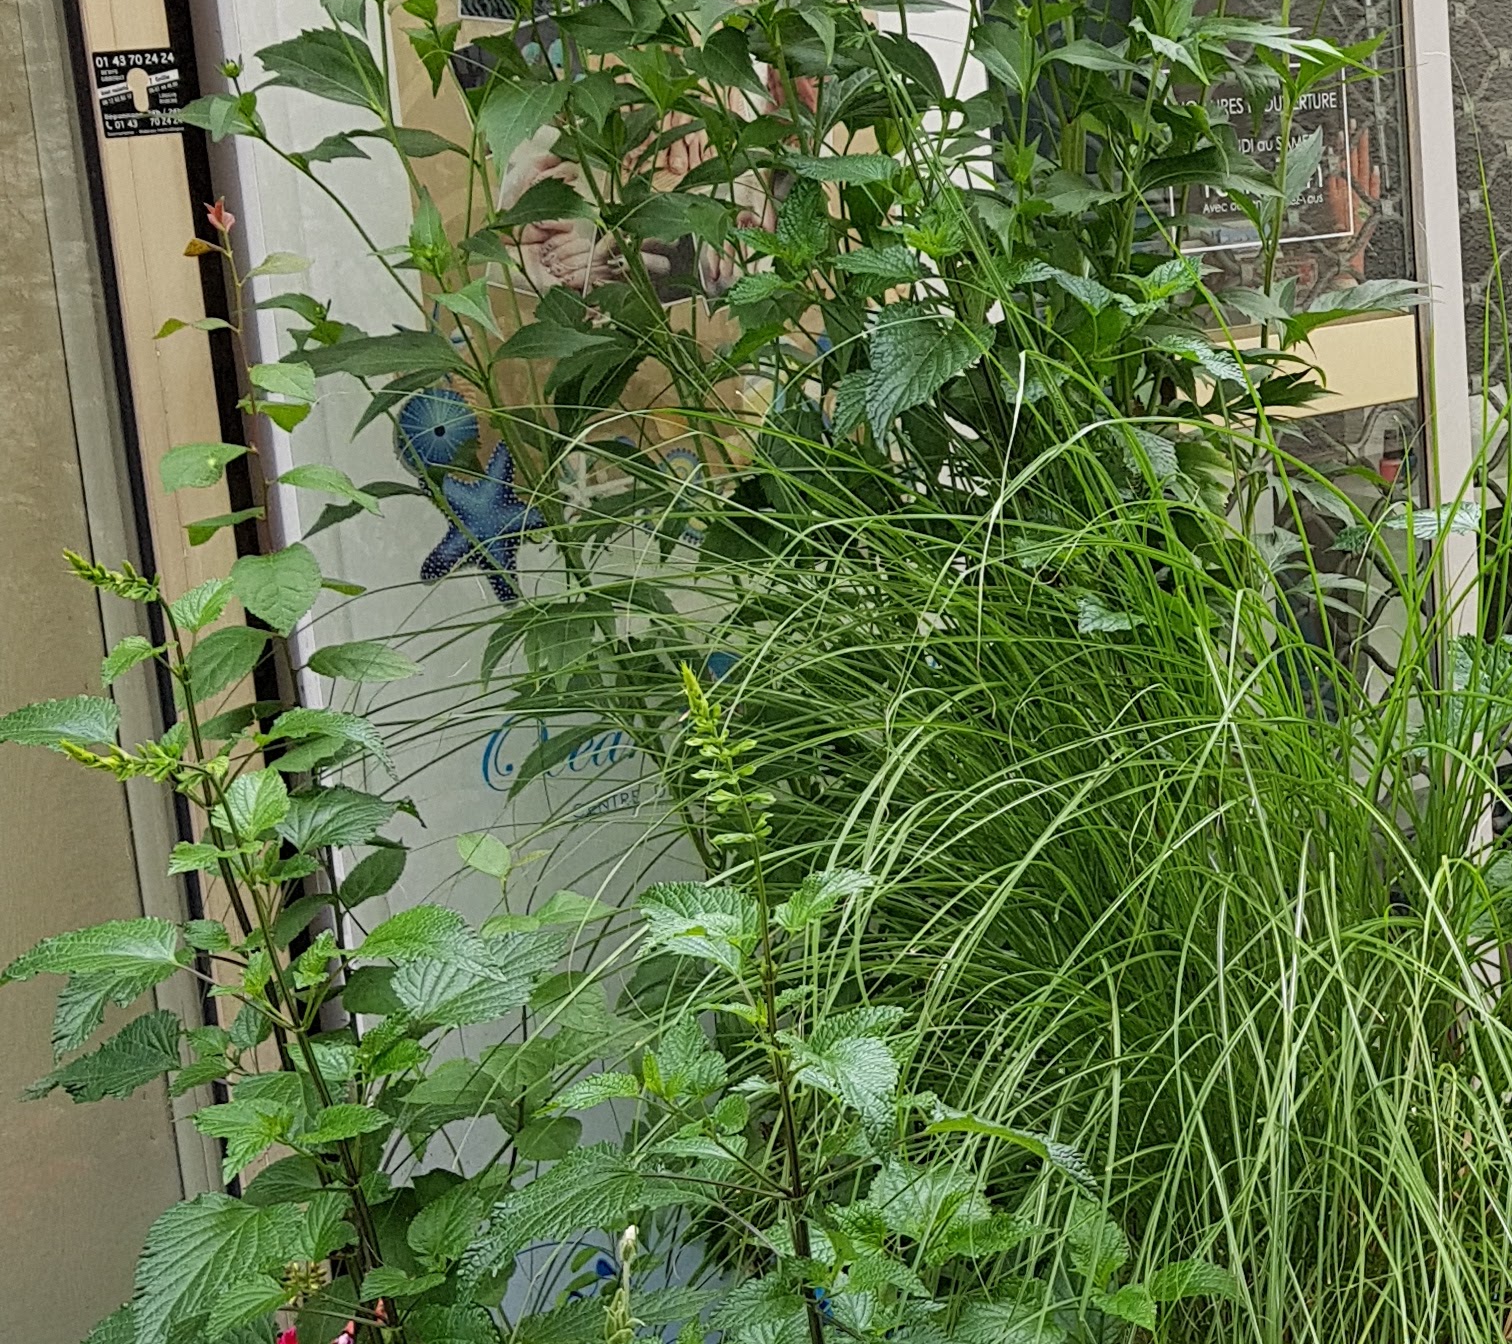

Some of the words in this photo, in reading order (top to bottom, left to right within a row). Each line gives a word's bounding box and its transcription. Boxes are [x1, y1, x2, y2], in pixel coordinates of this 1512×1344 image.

[95, 56, 109, 68] 01
[112, 54, 127, 67] 43
[128, 54, 143, 66] 70
[145, 53, 159, 65] 24
[160, 52, 174, 64] 24
[114, 120, 125, 130] 01
[127, 119, 138, 129] 43
[149, 117, 160, 127] 70
[1202, 203, 1228, 214] Avec
